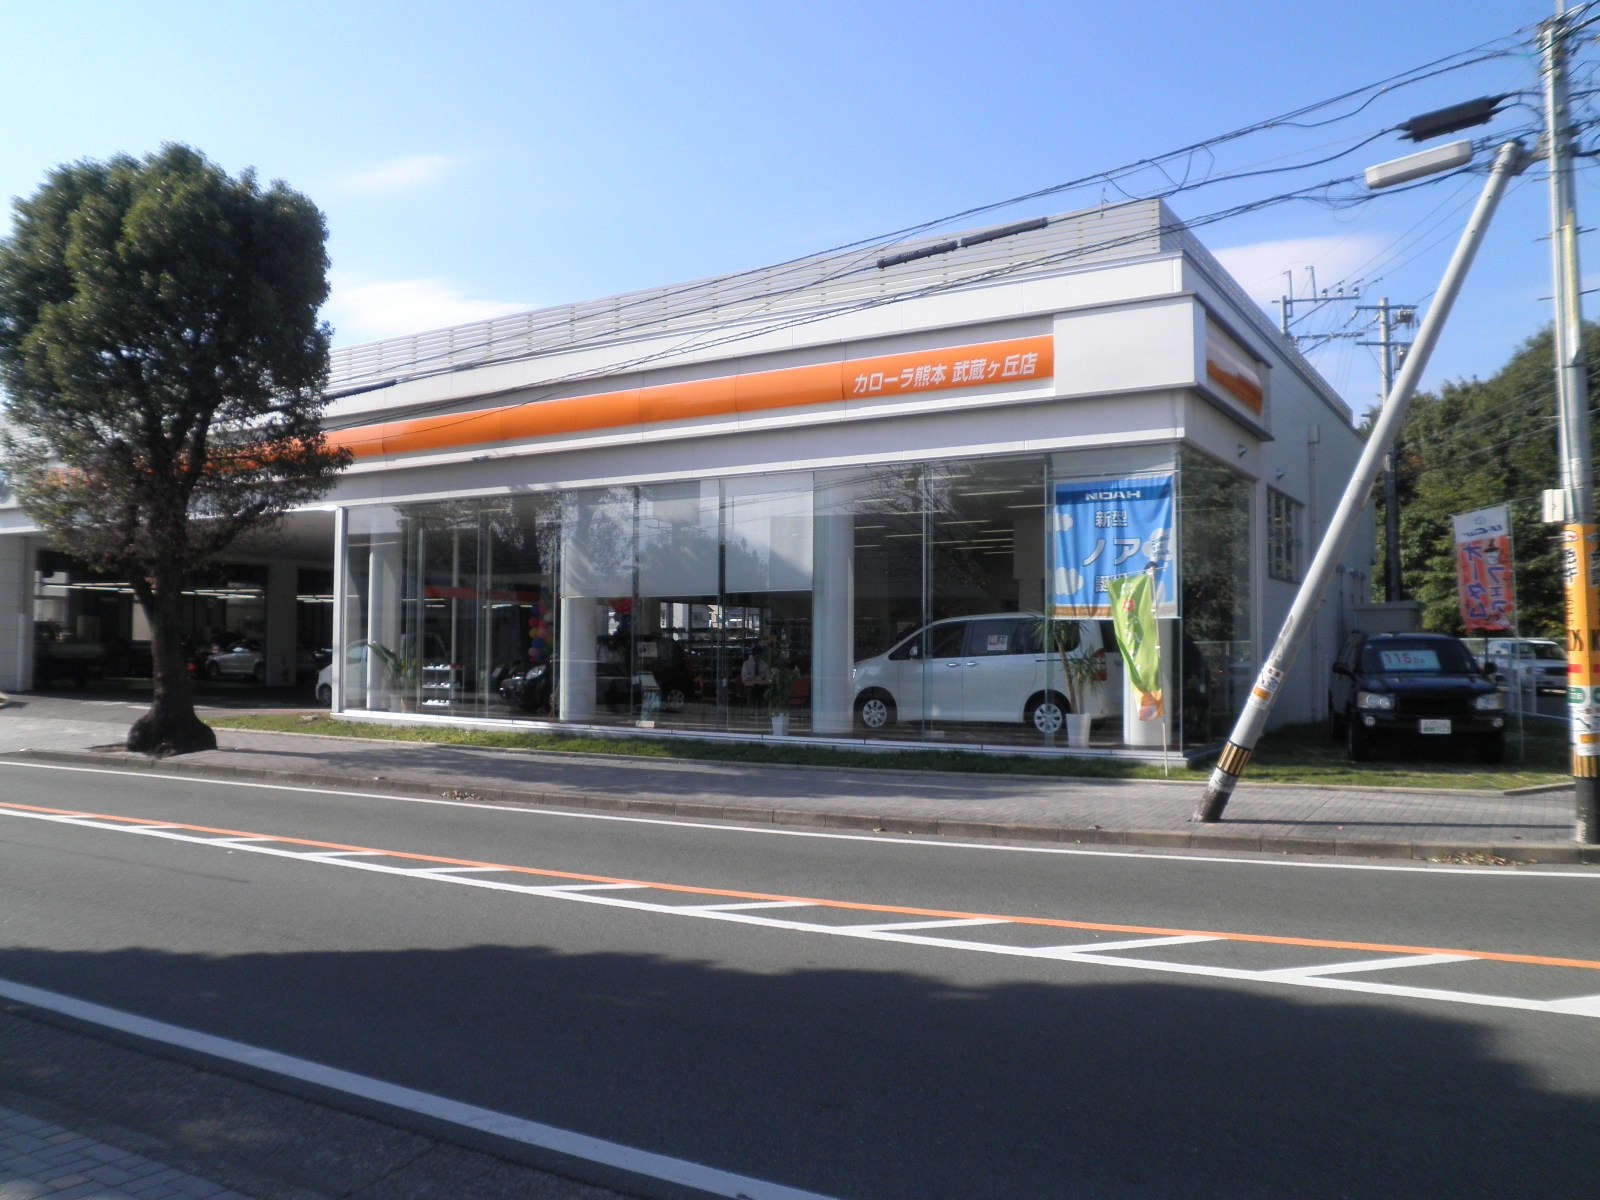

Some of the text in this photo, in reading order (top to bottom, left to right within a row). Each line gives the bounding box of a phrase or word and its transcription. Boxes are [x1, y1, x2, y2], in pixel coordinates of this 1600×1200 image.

[853, 364, 948, 393] カローラ熊本
[1085, 490, 1141, 501] NOAH
[1095, 509, 1128, 528] 新型
[1083, 538, 1141, 566] ノア
